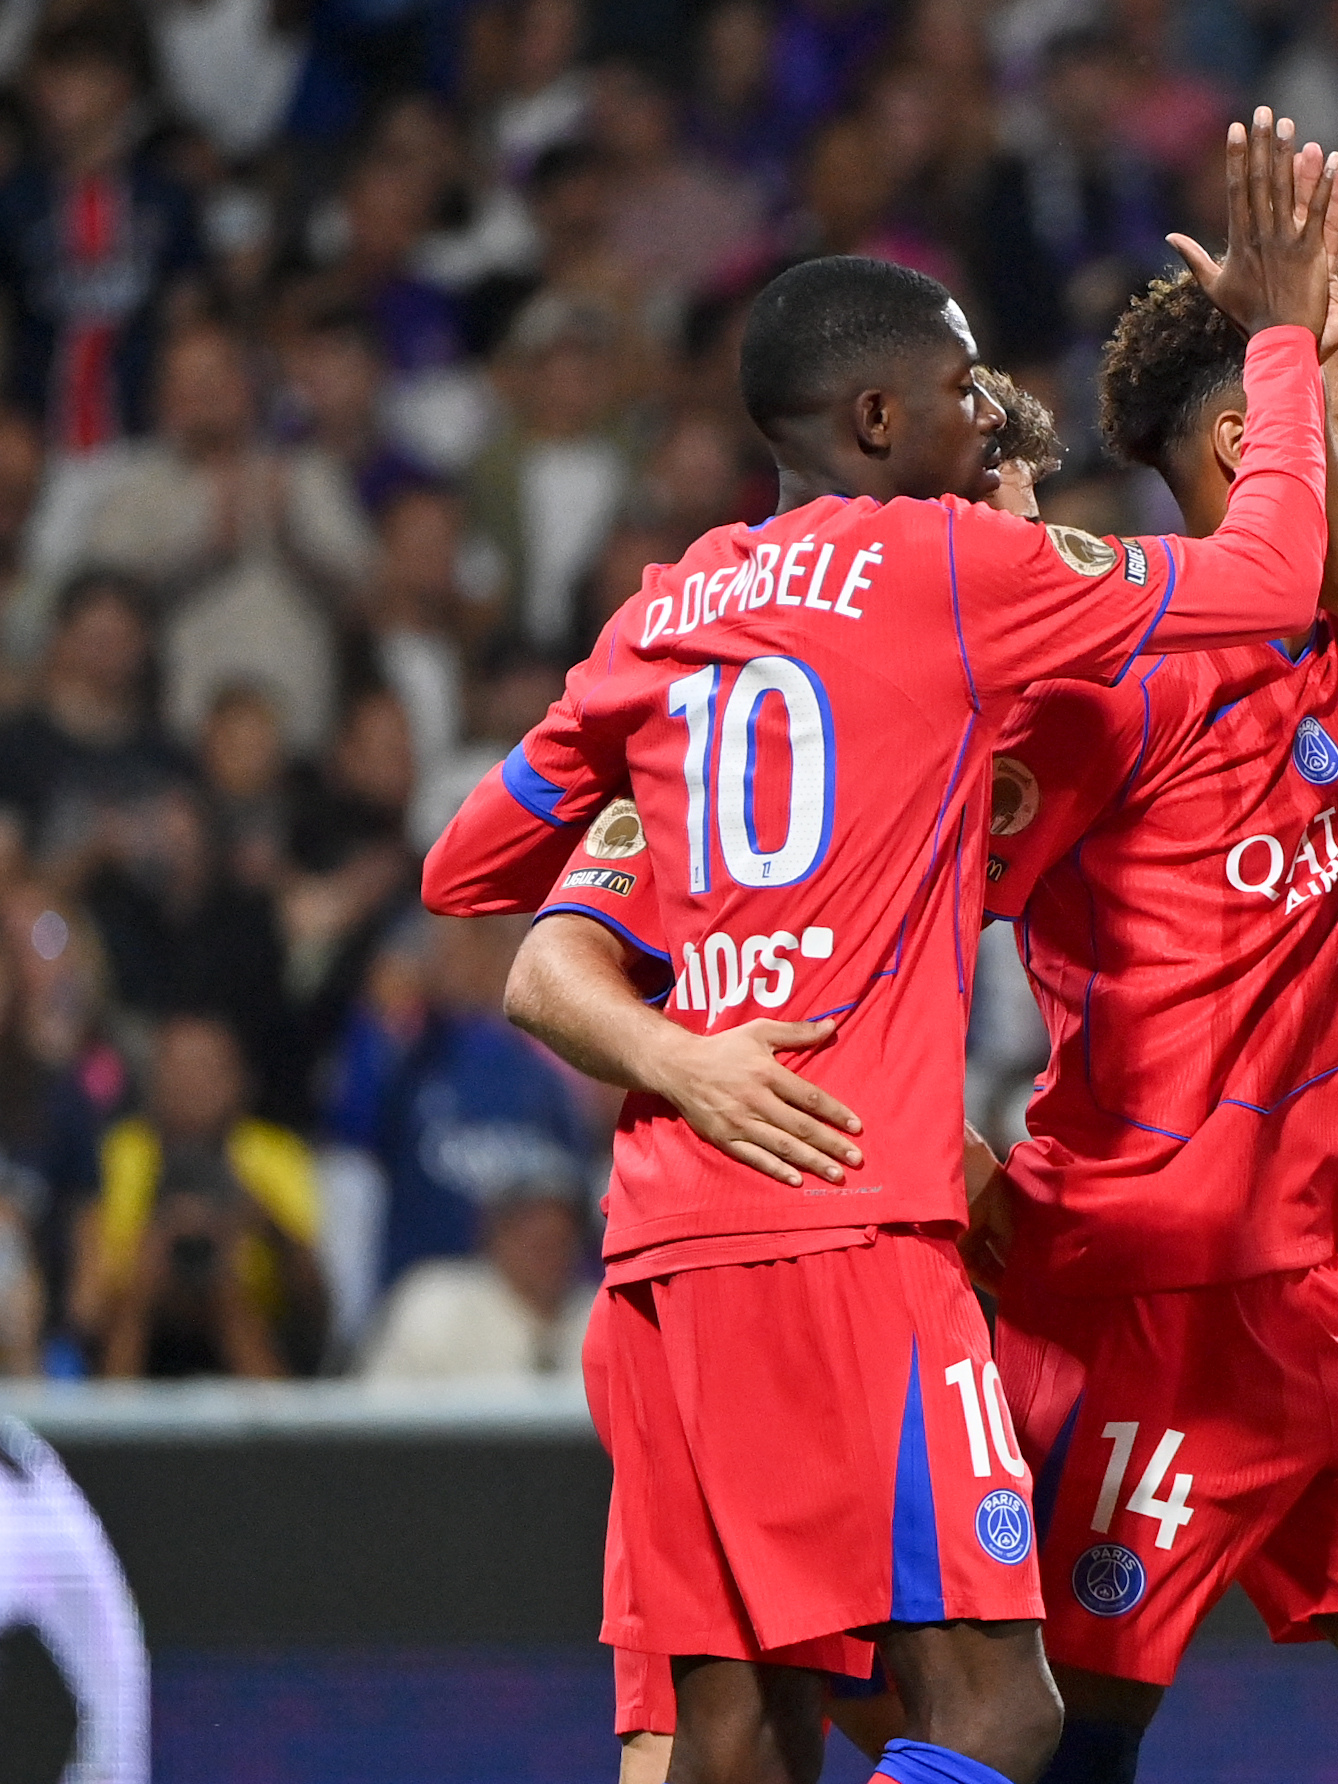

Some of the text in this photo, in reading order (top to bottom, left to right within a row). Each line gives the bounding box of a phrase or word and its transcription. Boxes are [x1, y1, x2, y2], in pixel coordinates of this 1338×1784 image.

[640, 534, 884, 648] D.DEMBÉLÉ
[668, 655, 837, 895] 10
[561, 870, 599, 888] LIGUE
[945, 1358, 1025, 1478] 10
[984, 1494, 1021, 1513] PARIS
[1090, 1421, 1194, 1550] 14
[1091, 1548, 1137, 1571] PARIS
